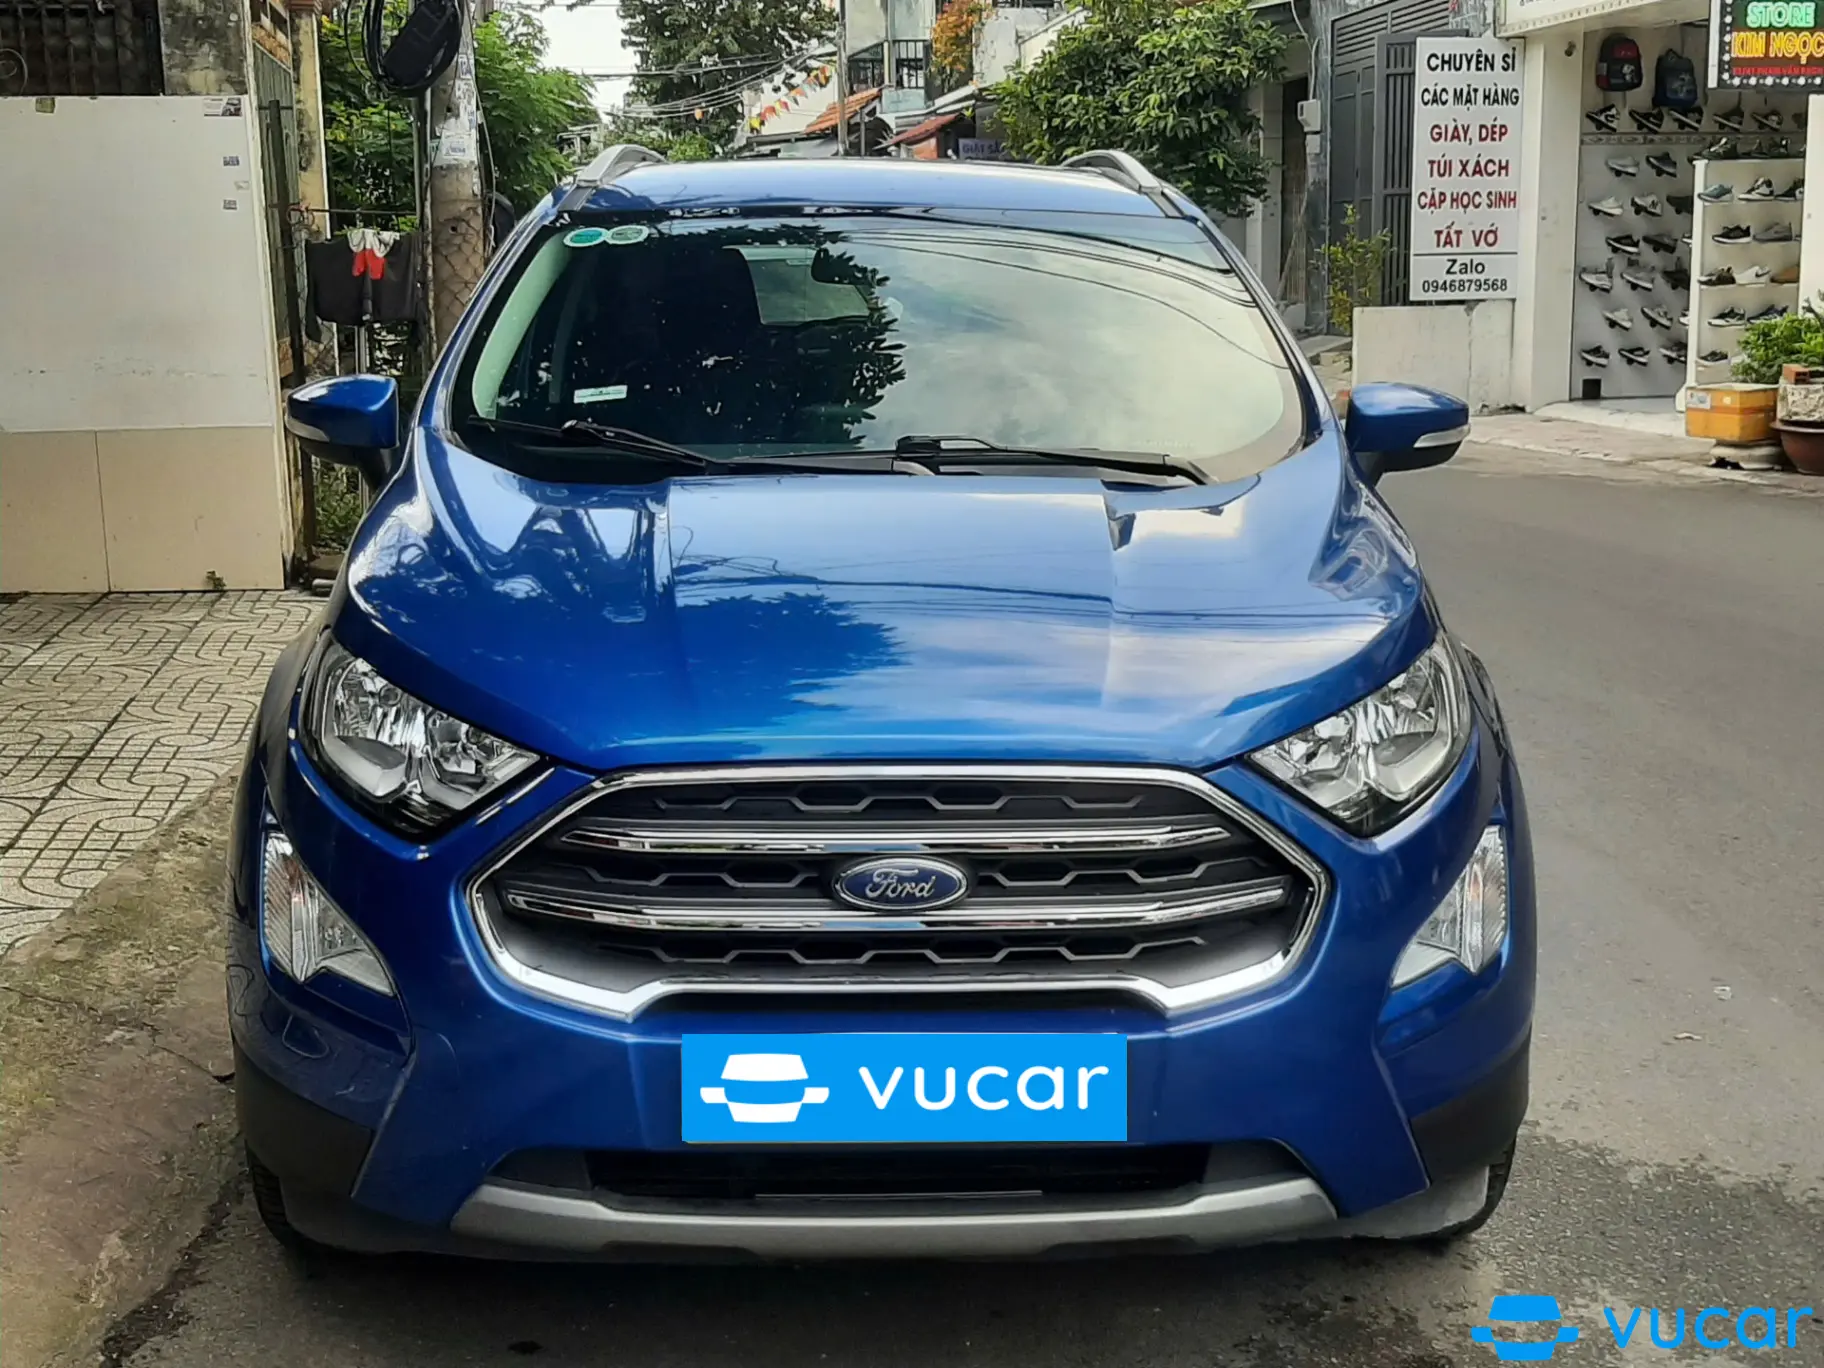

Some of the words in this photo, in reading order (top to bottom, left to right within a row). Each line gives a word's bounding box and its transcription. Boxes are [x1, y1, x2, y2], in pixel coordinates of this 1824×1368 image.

[1746, 2, 1816, 28] STORE
[1426, 48, 1495, 72] CHUYÊN
[1731, 31, 1766, 57] KIM
[1769, 31, 1824, 65] NGỌC
[1421, 82, 1449, 106] CÁC
[1453, 83, 1479, 112] MẶT
[1482, 82, 1520, 106] HÀNG
[1430, 118, 1473, 146] GIÀY,
[1478, 116, 1508, 142] DÉP
[1428, 153, 1452, 178] TÚI
[1458, 153, 1509, 177] XÁCH
[1417, 187, 1447, 215] CẶP
[1450, 191, 1482, 215] HỌC
[1486, 191, 1517, 209] SINH
[1434, 220, 1463, 248] TẤT
[1471, 222, 1499, 247] VỚ
[1445, 258, 1486, 275] Zalo
[1422, 278, 1508, 293] 0946879568
[865, 868, 936, 897] Ford
